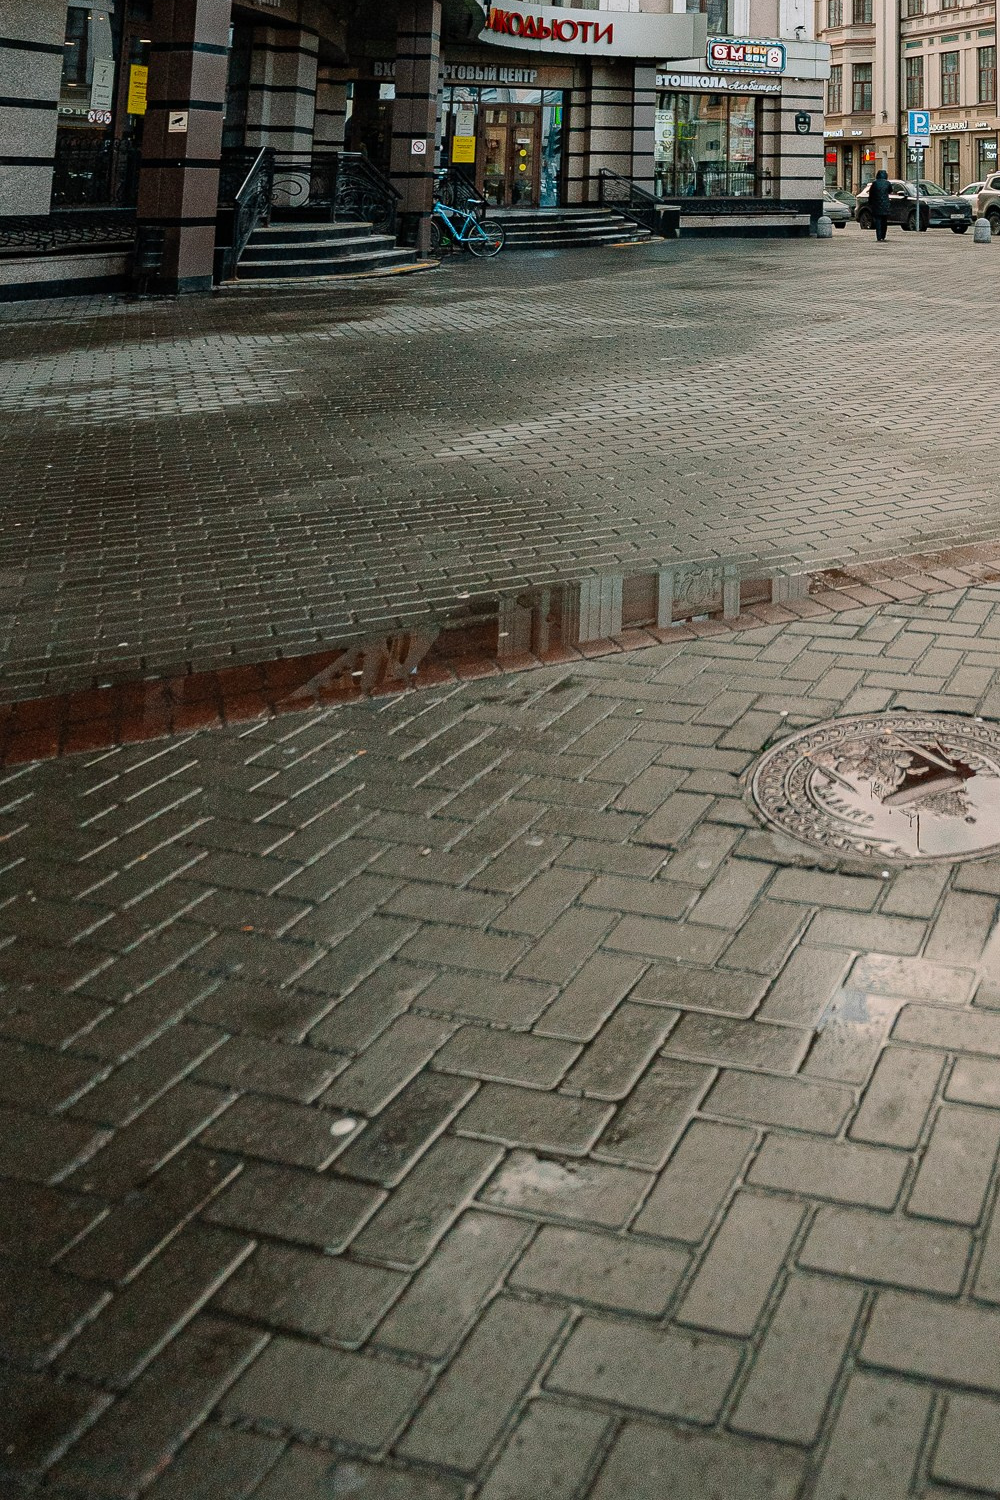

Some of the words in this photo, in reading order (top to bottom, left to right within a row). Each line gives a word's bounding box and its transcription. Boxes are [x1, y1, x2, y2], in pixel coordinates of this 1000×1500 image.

[443, 64, 497, 81] РГОВЫЙ
[499, 66, 538, 84] ЦЕНТР
[655, 74, 728, 88] ВТОШКОЛА
